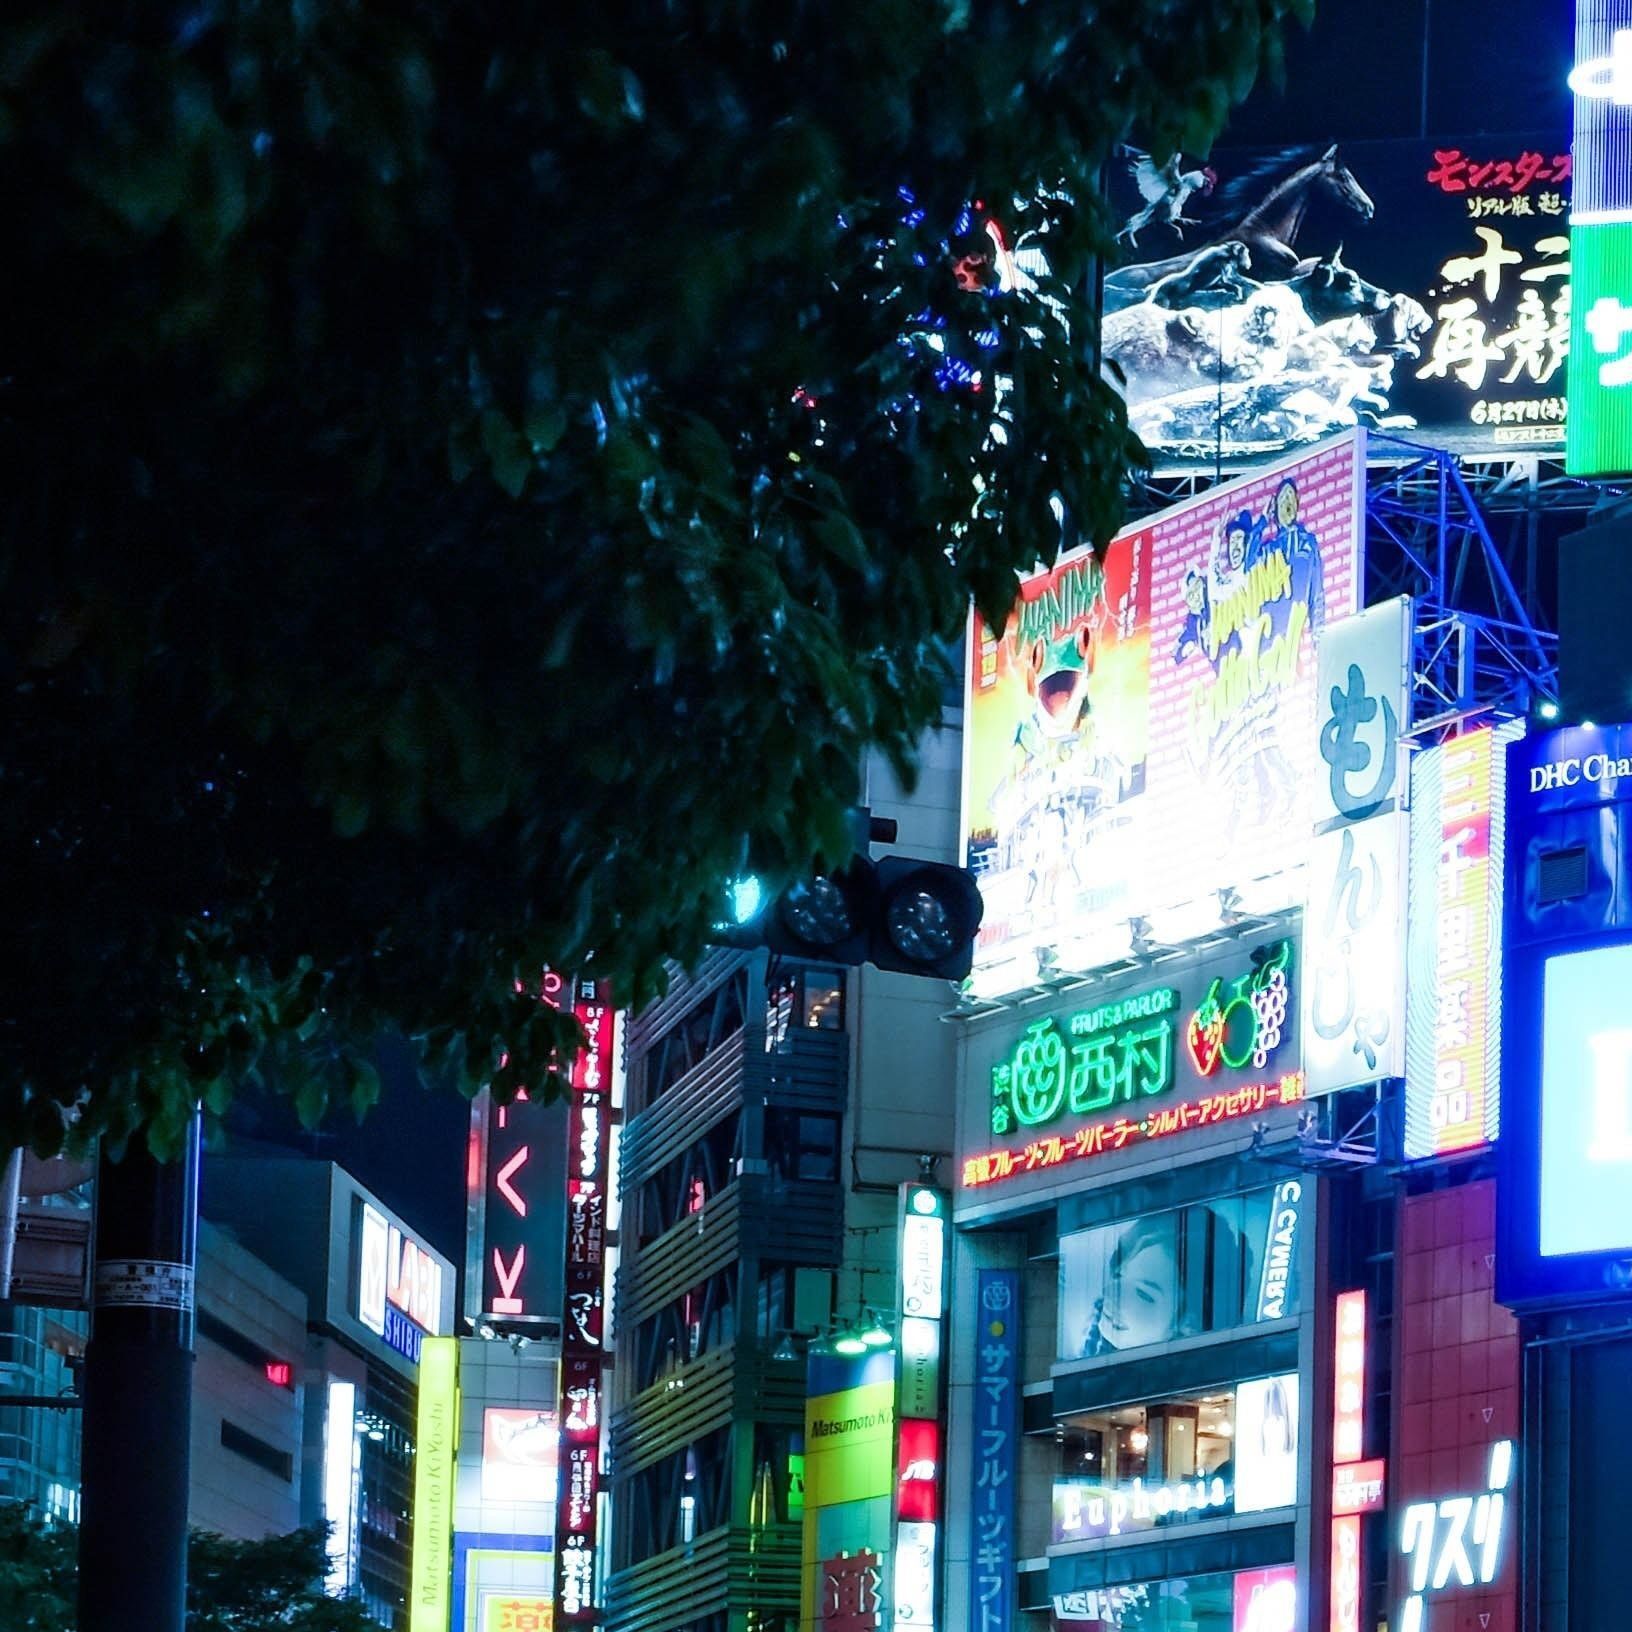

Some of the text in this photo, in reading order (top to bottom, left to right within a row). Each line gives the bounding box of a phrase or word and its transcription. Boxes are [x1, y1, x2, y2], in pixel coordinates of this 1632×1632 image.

[1530, 759, 1581, 792] DHC
[1071, 1021, 1171, 1114] 西村
[811, 1412, 875, 1439] Matsumoto
[1063, 1469, 1231, 1536] Euphoria
